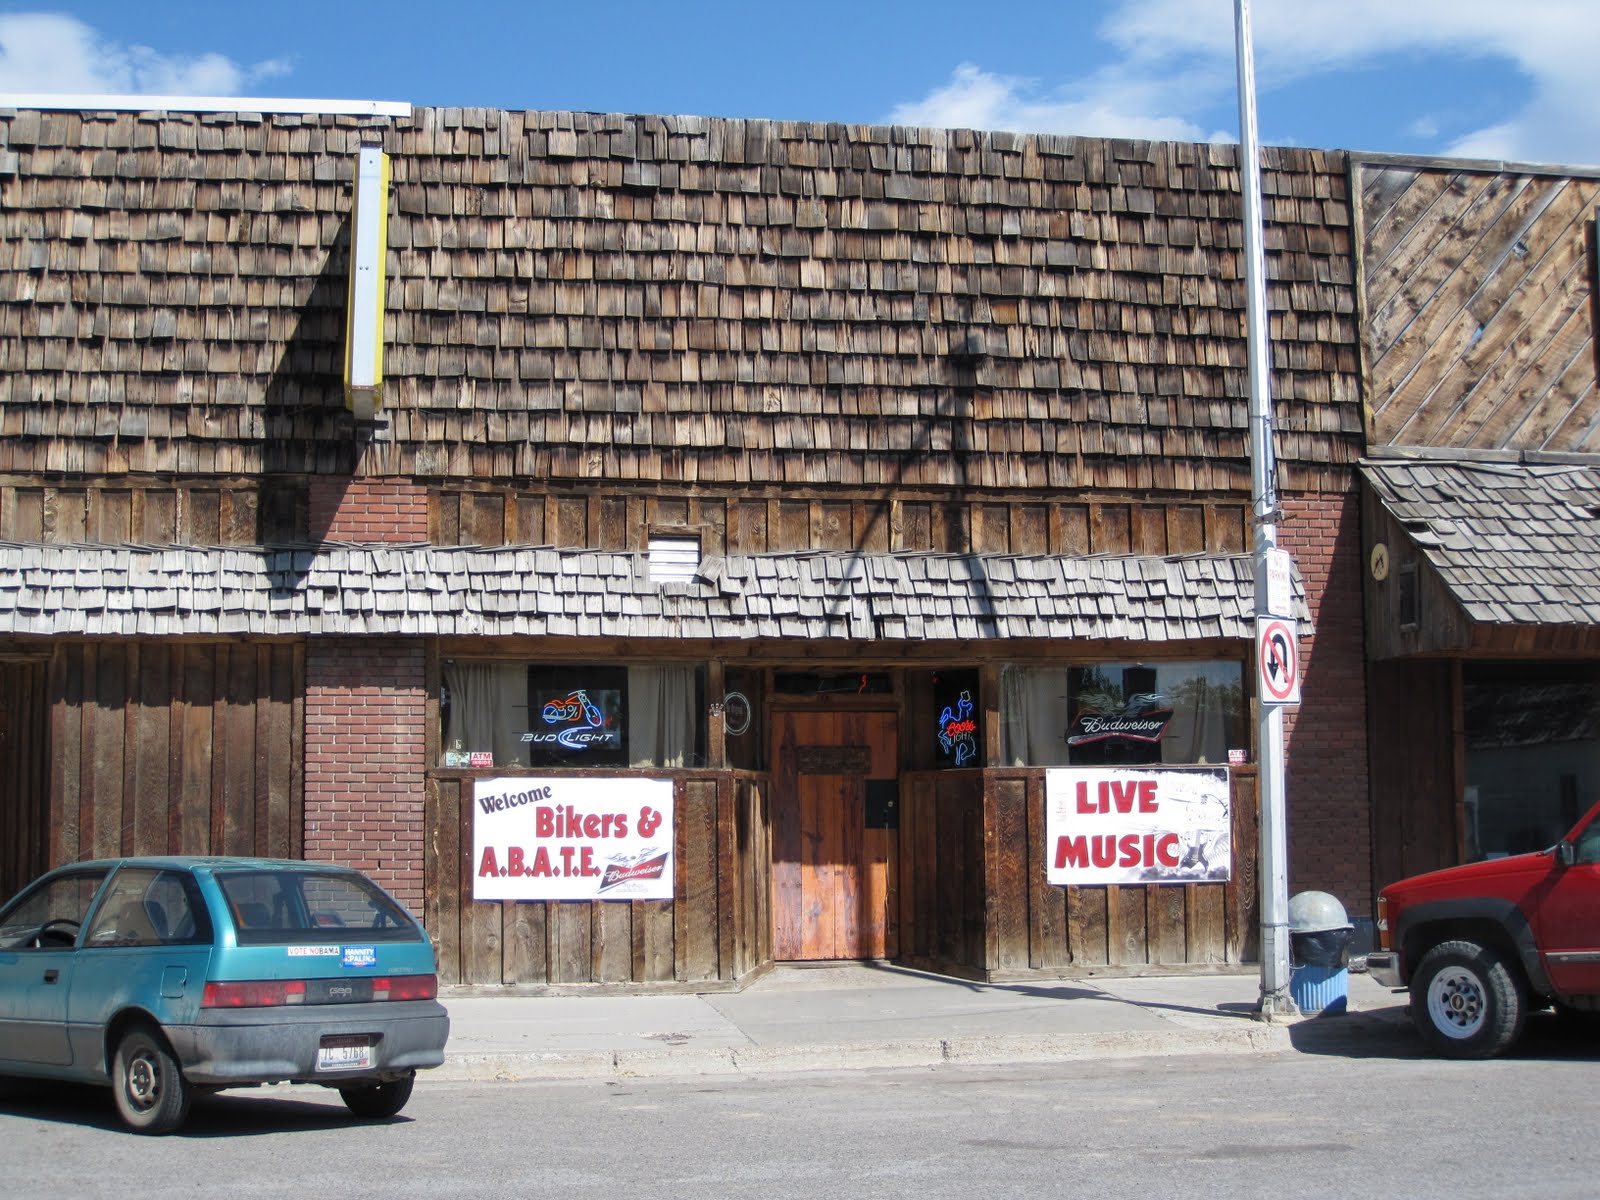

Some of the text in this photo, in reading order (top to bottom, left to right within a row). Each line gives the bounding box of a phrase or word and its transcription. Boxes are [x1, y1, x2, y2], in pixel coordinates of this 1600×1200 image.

[946, 720, 977, 737] Coors
[1080, 716, 1164, 733] Budweiser
[520, 733, 614, 742] BUD LIGHT
[478, 785, 552, 815] Welcome
[1076, 780, 1159, 814] LIVE
[535, 804, 663, 839] Bikers &
[1054, 832, 1180, 869] MUSIC
[478, 846, 602, 878] A.B.A.T.E.
[604, 864, 664, 882] Budweiser
[289, 947, 308, 955] VOTE
[309, 947, 339, 955] NOBAMA
[344, 948, 375, 956] HANNITY
